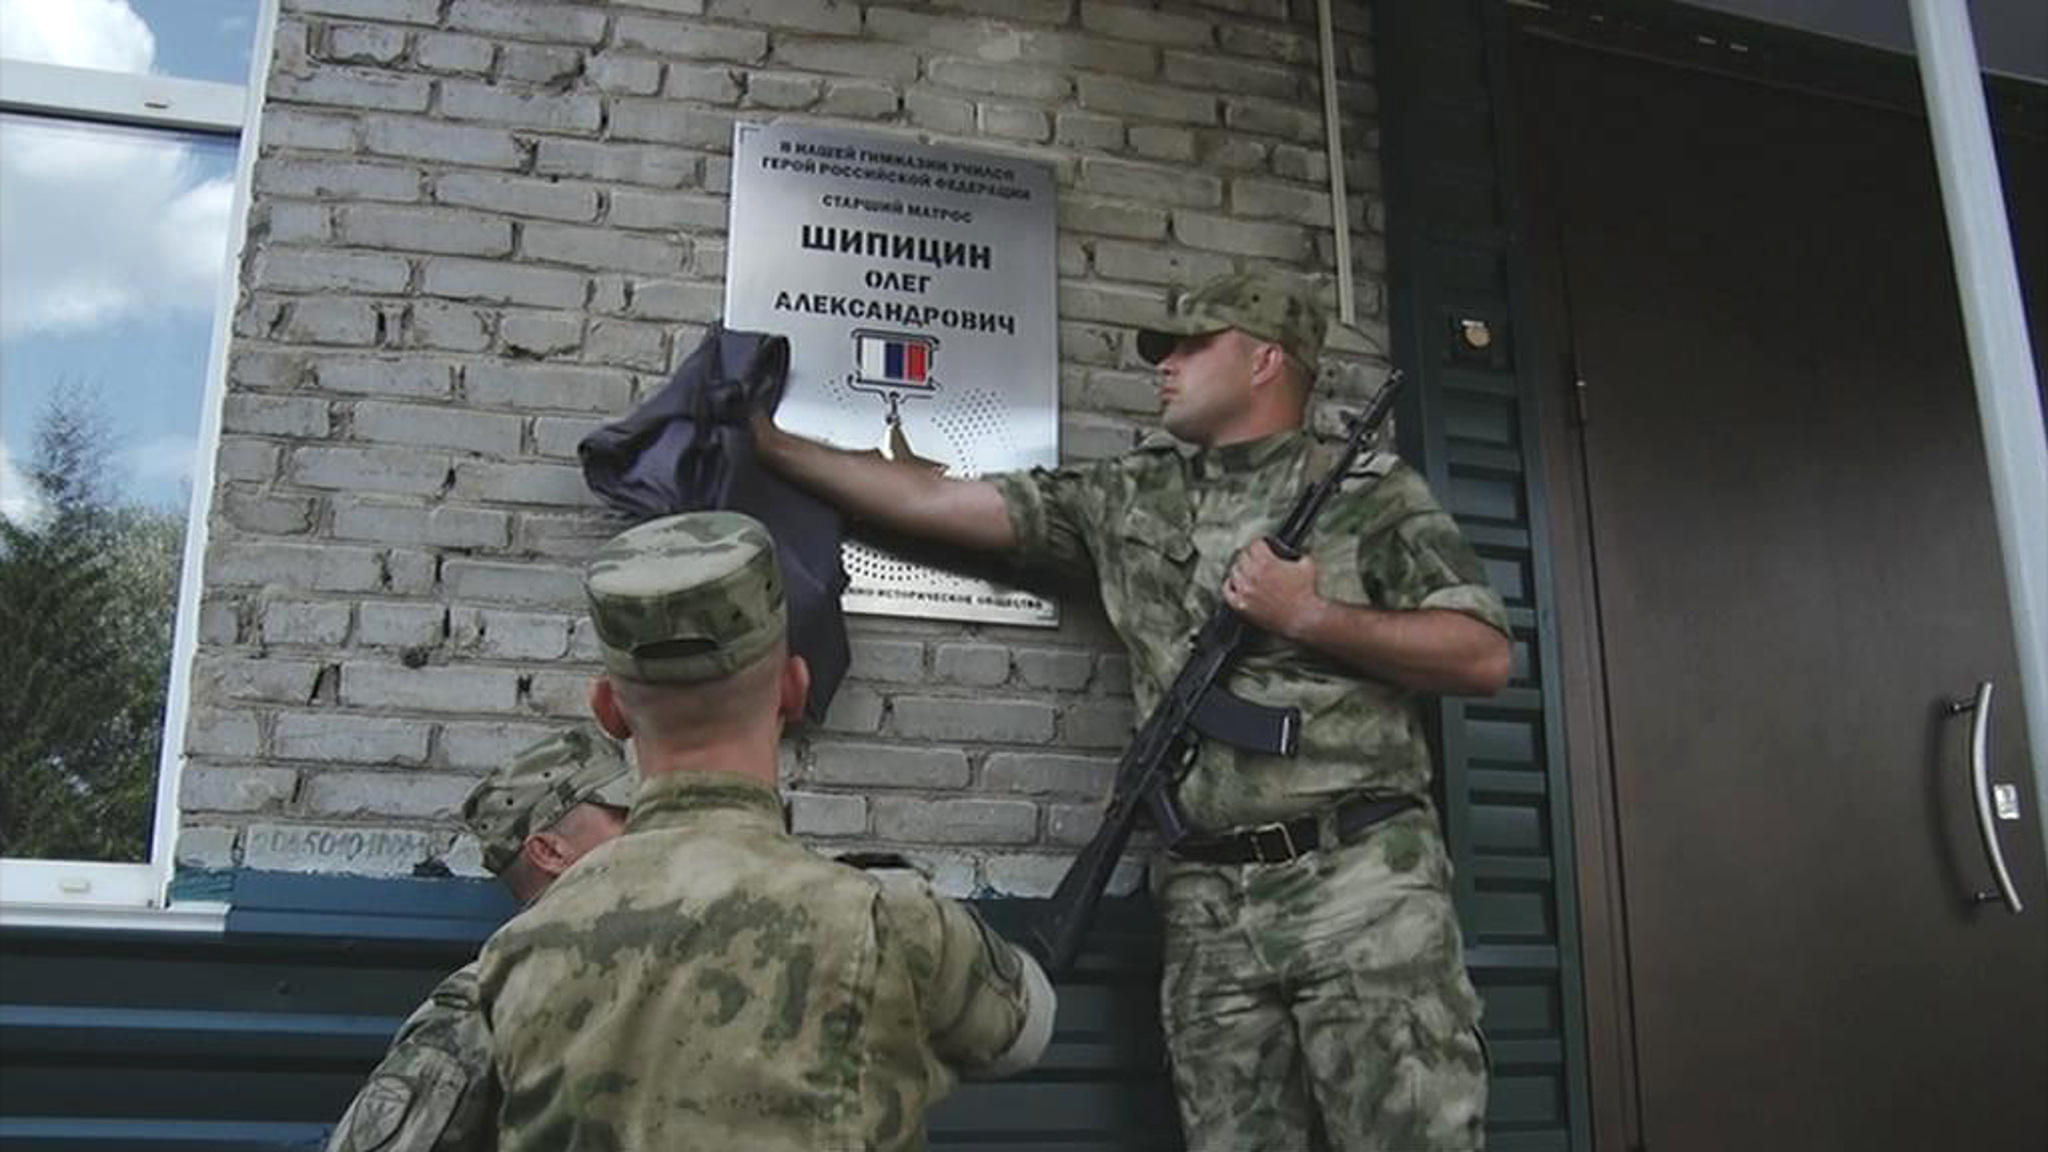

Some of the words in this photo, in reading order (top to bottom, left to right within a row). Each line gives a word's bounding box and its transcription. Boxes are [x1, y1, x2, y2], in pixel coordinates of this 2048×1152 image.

[762, 155, 817, 174] ГЕРОЙ
[818, 162, 931, 188] РОССИЙСКОЙ
[934, 177, 1031, 201] ФЕДЕРАЦИИ
[780, 141, 791, 154] В
[795, 142, 857, 163] НАШЕЙ
[859, 150, 949, 172] ГИМНАЗИИ
[952, 161, 1015, 180] УЧИЛСЯ
[822, 194, 904, 216] СТАРШИЙ
[907, 205, 972, 224] МАТРОС
[802, 225, 992, 270] ШИПИЦИН
[865, 270, 931, 294] ОЛЕГ
[774, 291, 1016, 335] АЛЕКСАНДРОВИЧ
